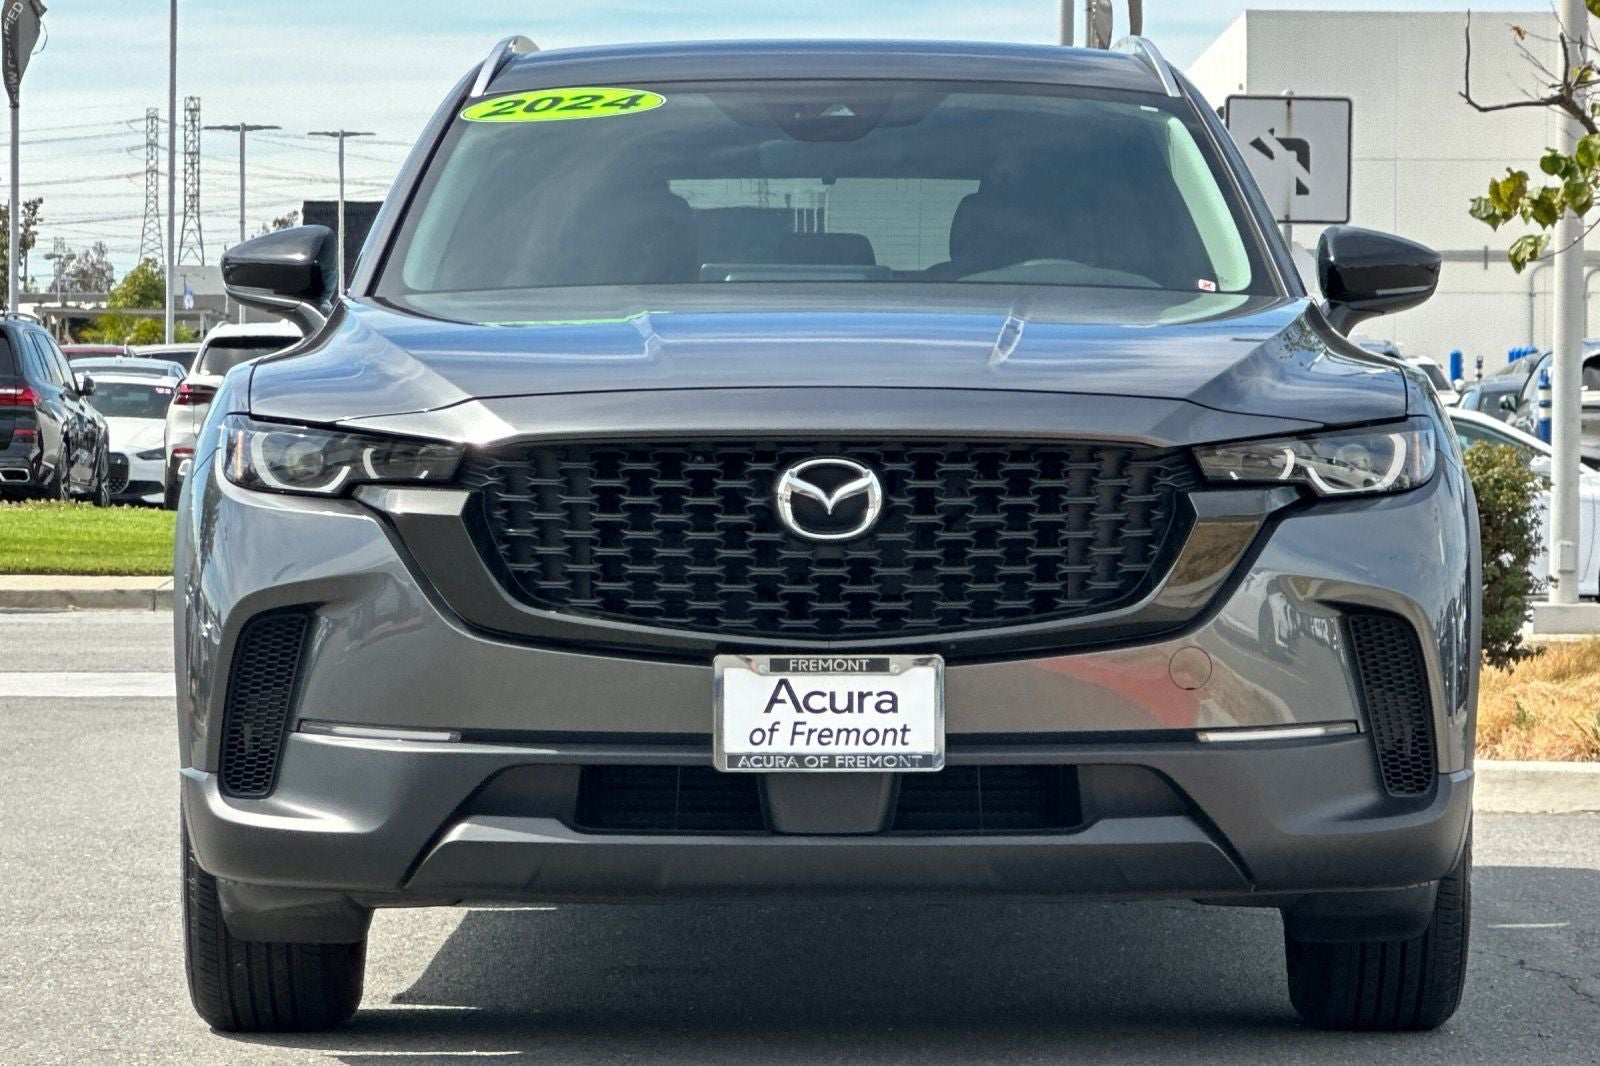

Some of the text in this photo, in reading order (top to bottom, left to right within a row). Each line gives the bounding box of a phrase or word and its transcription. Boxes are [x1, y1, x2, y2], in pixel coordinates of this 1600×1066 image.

[478, 94, 646, 118] 2024
[789, 658, 869, 672] FREMONT
[763, 678, 899, 714] Acura
[749, 721, 912, 747] of Fremont
[737, 755, 923, 768] ACURA OF FREMONT
